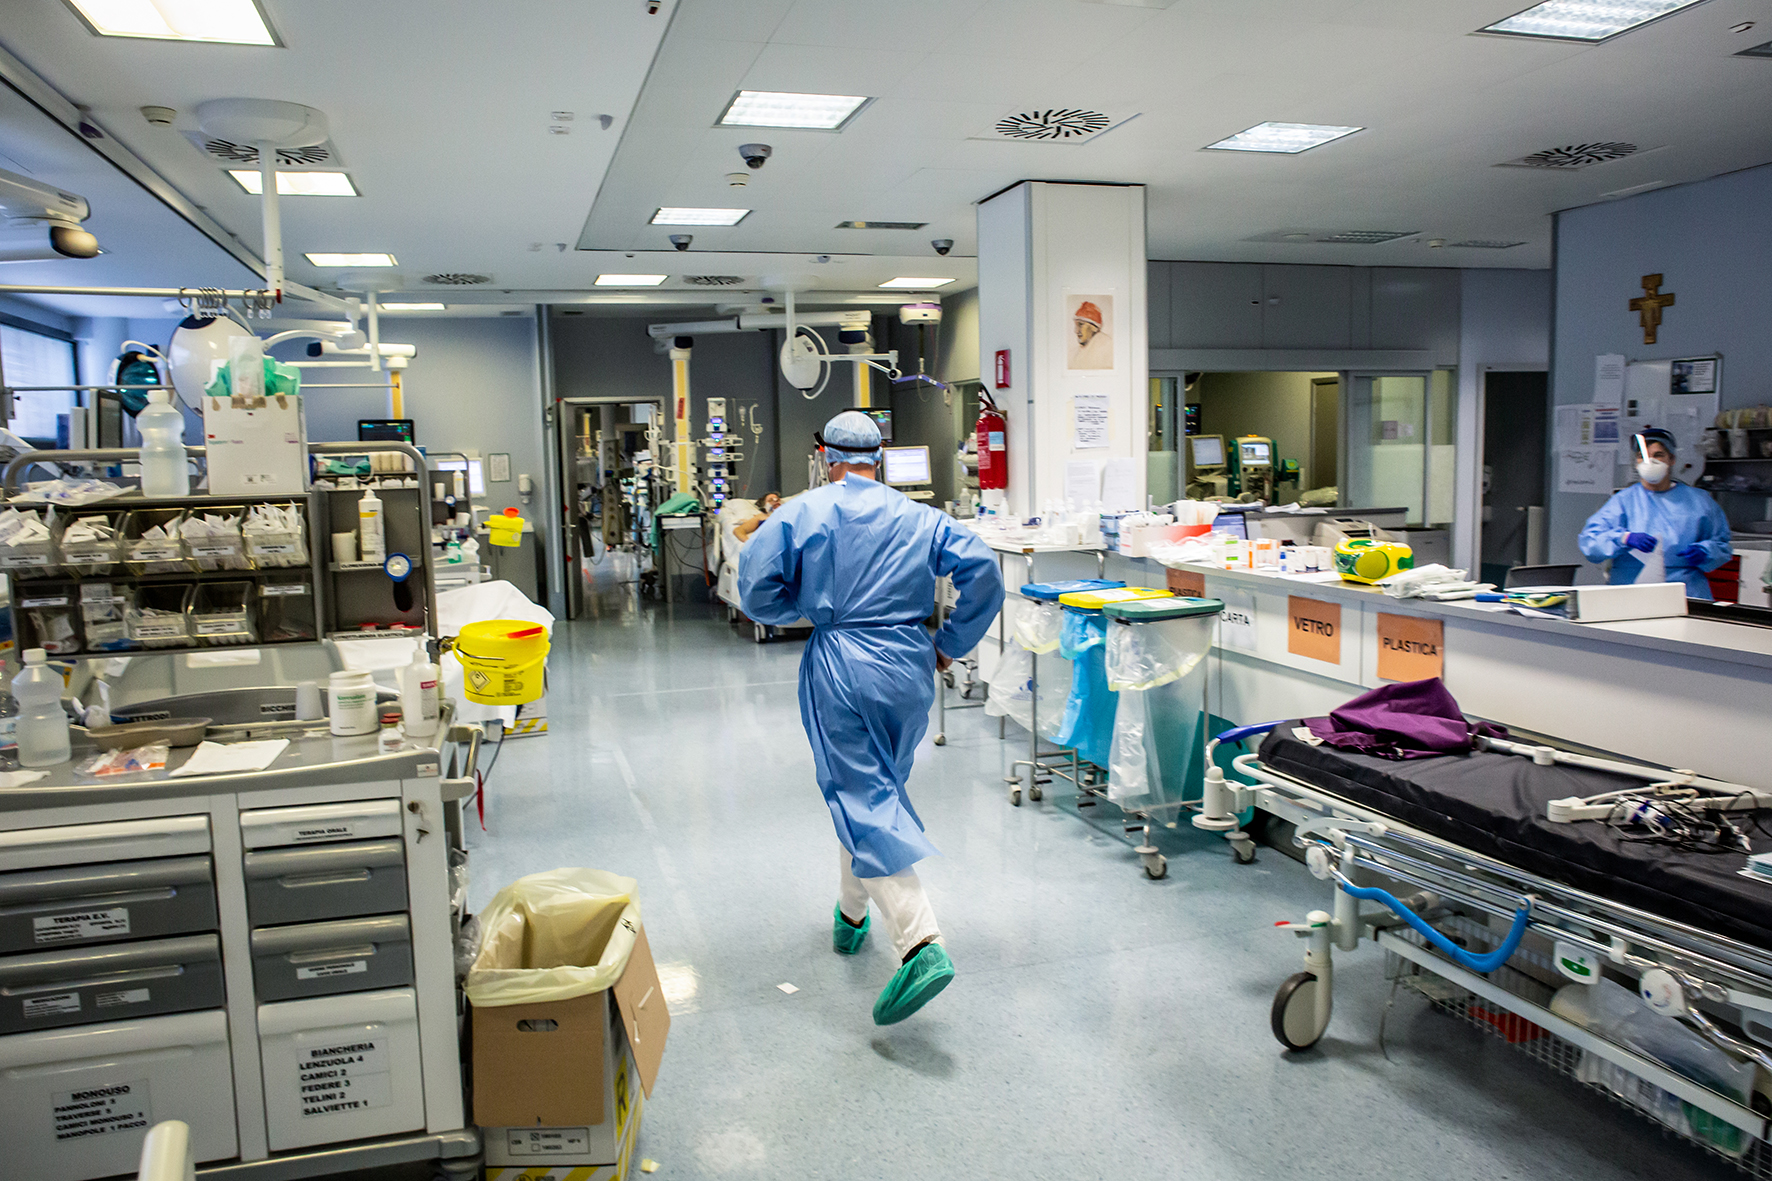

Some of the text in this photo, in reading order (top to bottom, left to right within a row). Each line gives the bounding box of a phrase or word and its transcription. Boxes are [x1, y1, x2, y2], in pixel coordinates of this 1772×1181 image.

[1220, 610, 1250, 626] CARTA
[1294, 615, 1334, 637] VETRO
[1383, 637, 1438, 657] PLASTICA
[53, 914, 91, 924] TERAPIA
[311, 1042, 375, 1057] BIANCHERIA
[299, 1056, 355, 1070] LENZUOLA
[301, 1069, 338, 1081] CAMICI
[71, 1085, 130, 1100] MONOUSO
[301, 1081, 342, 1093] FEDERE
[302, 1093, 337, 1104] TELINI
[303, 1100, 360, 1116] SALVIETTE
[56, 1121, 88, 1131] CAMICI
[90, 1113, 134, 1126] MONOUSO
[117, 1120, 147, 1131] PACCO
